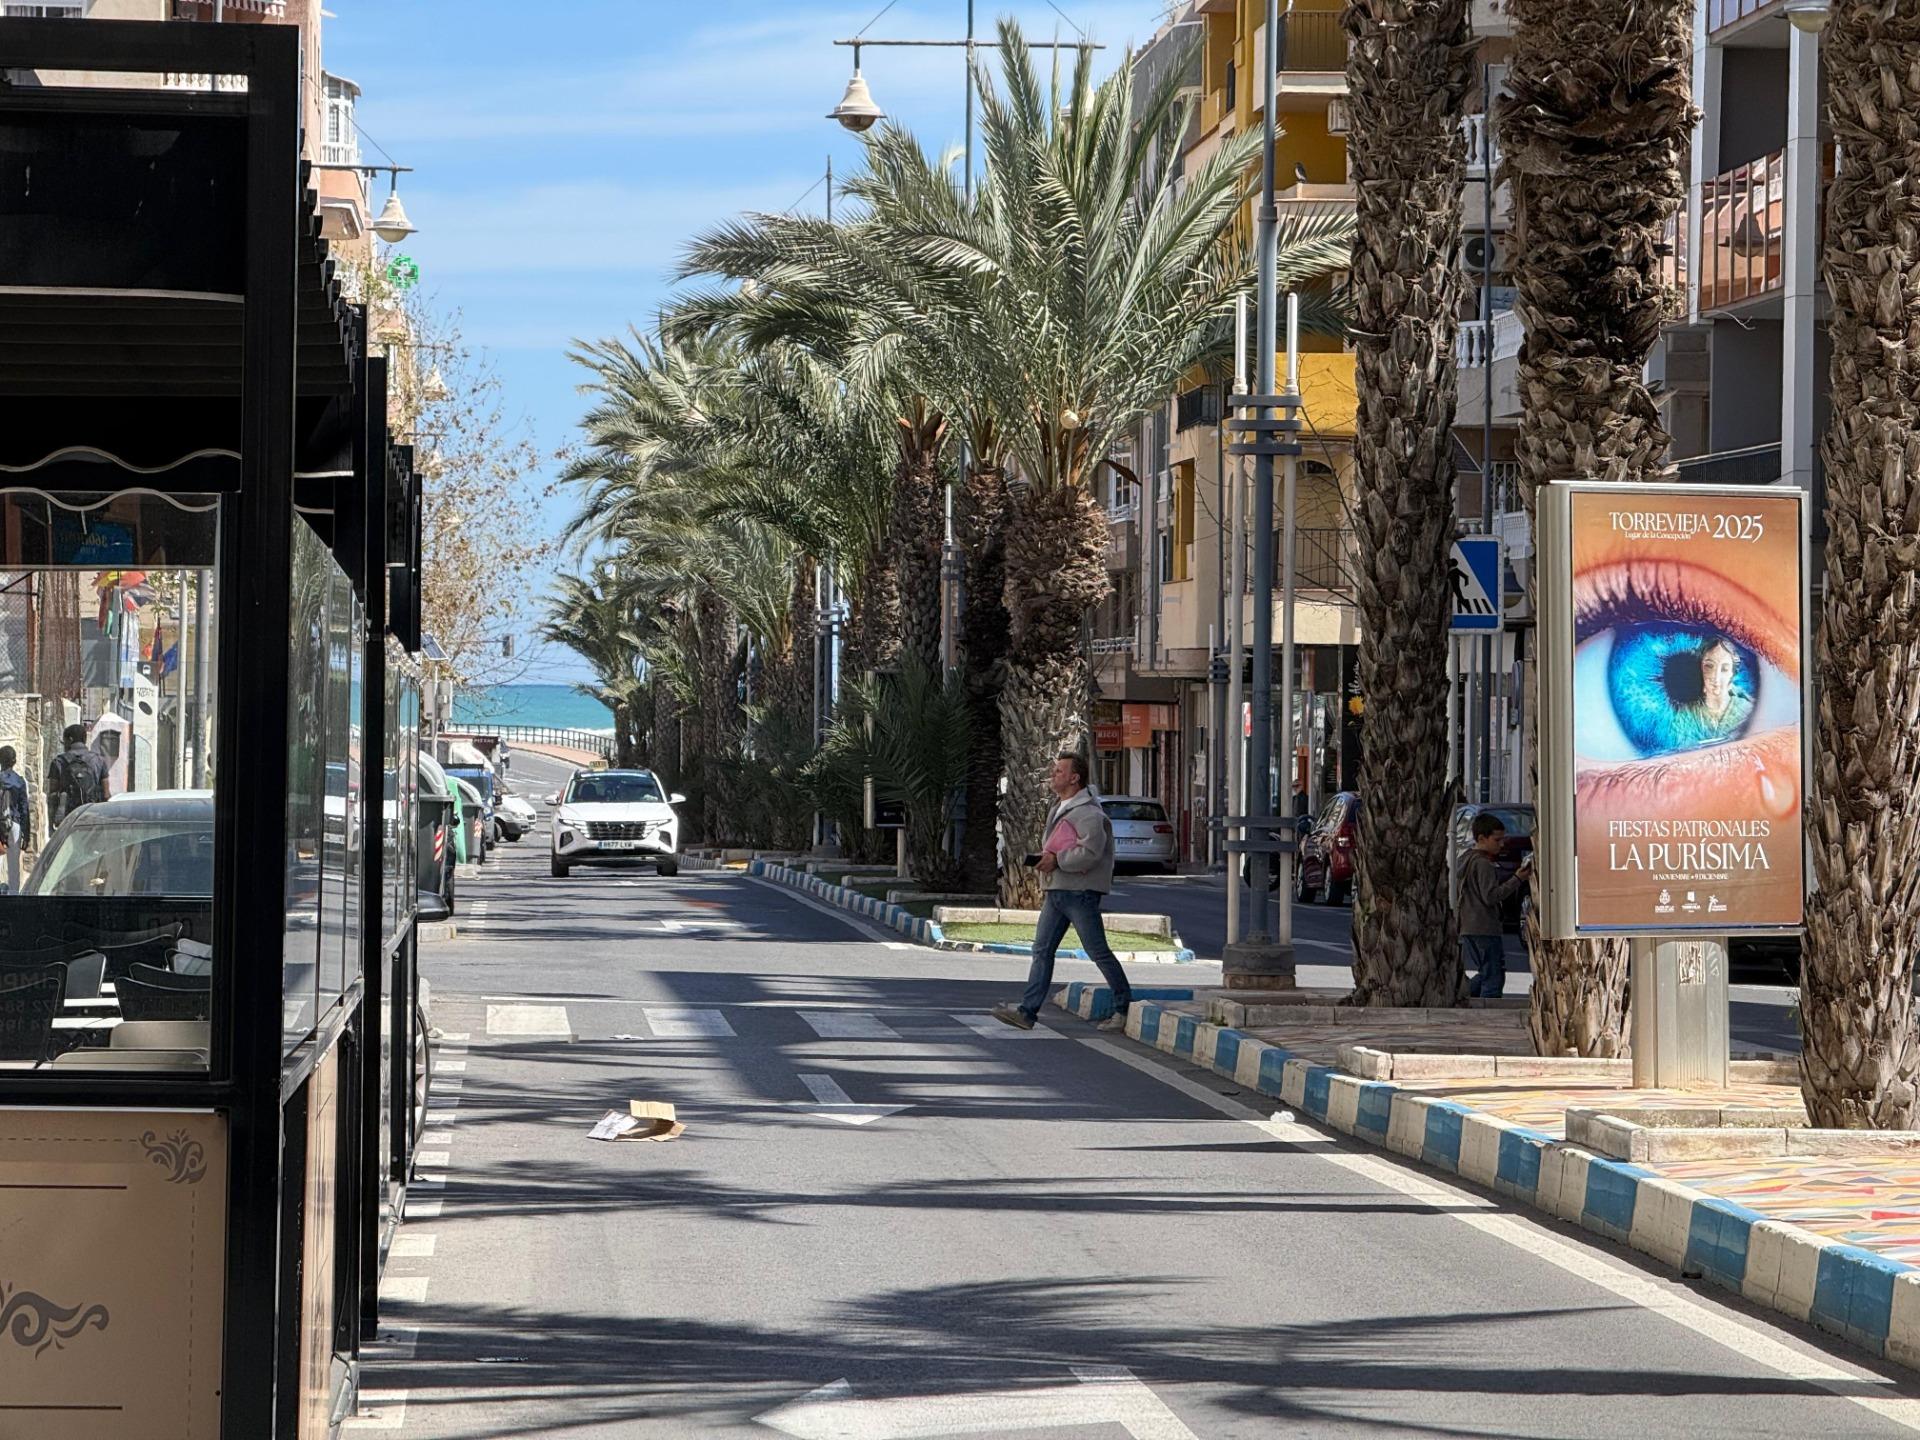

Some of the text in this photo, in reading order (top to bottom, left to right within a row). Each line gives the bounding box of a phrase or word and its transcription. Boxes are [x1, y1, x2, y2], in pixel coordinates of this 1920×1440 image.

[1609, 512, 1764, 543] TORREVIEJA 2025
[1625, 532, 1641, 540] Lugar
[1609, 820, 1770, 837] FIESTAS PATRONALES
[1610, 838, 1770, 870] LA PURÍSIMA
